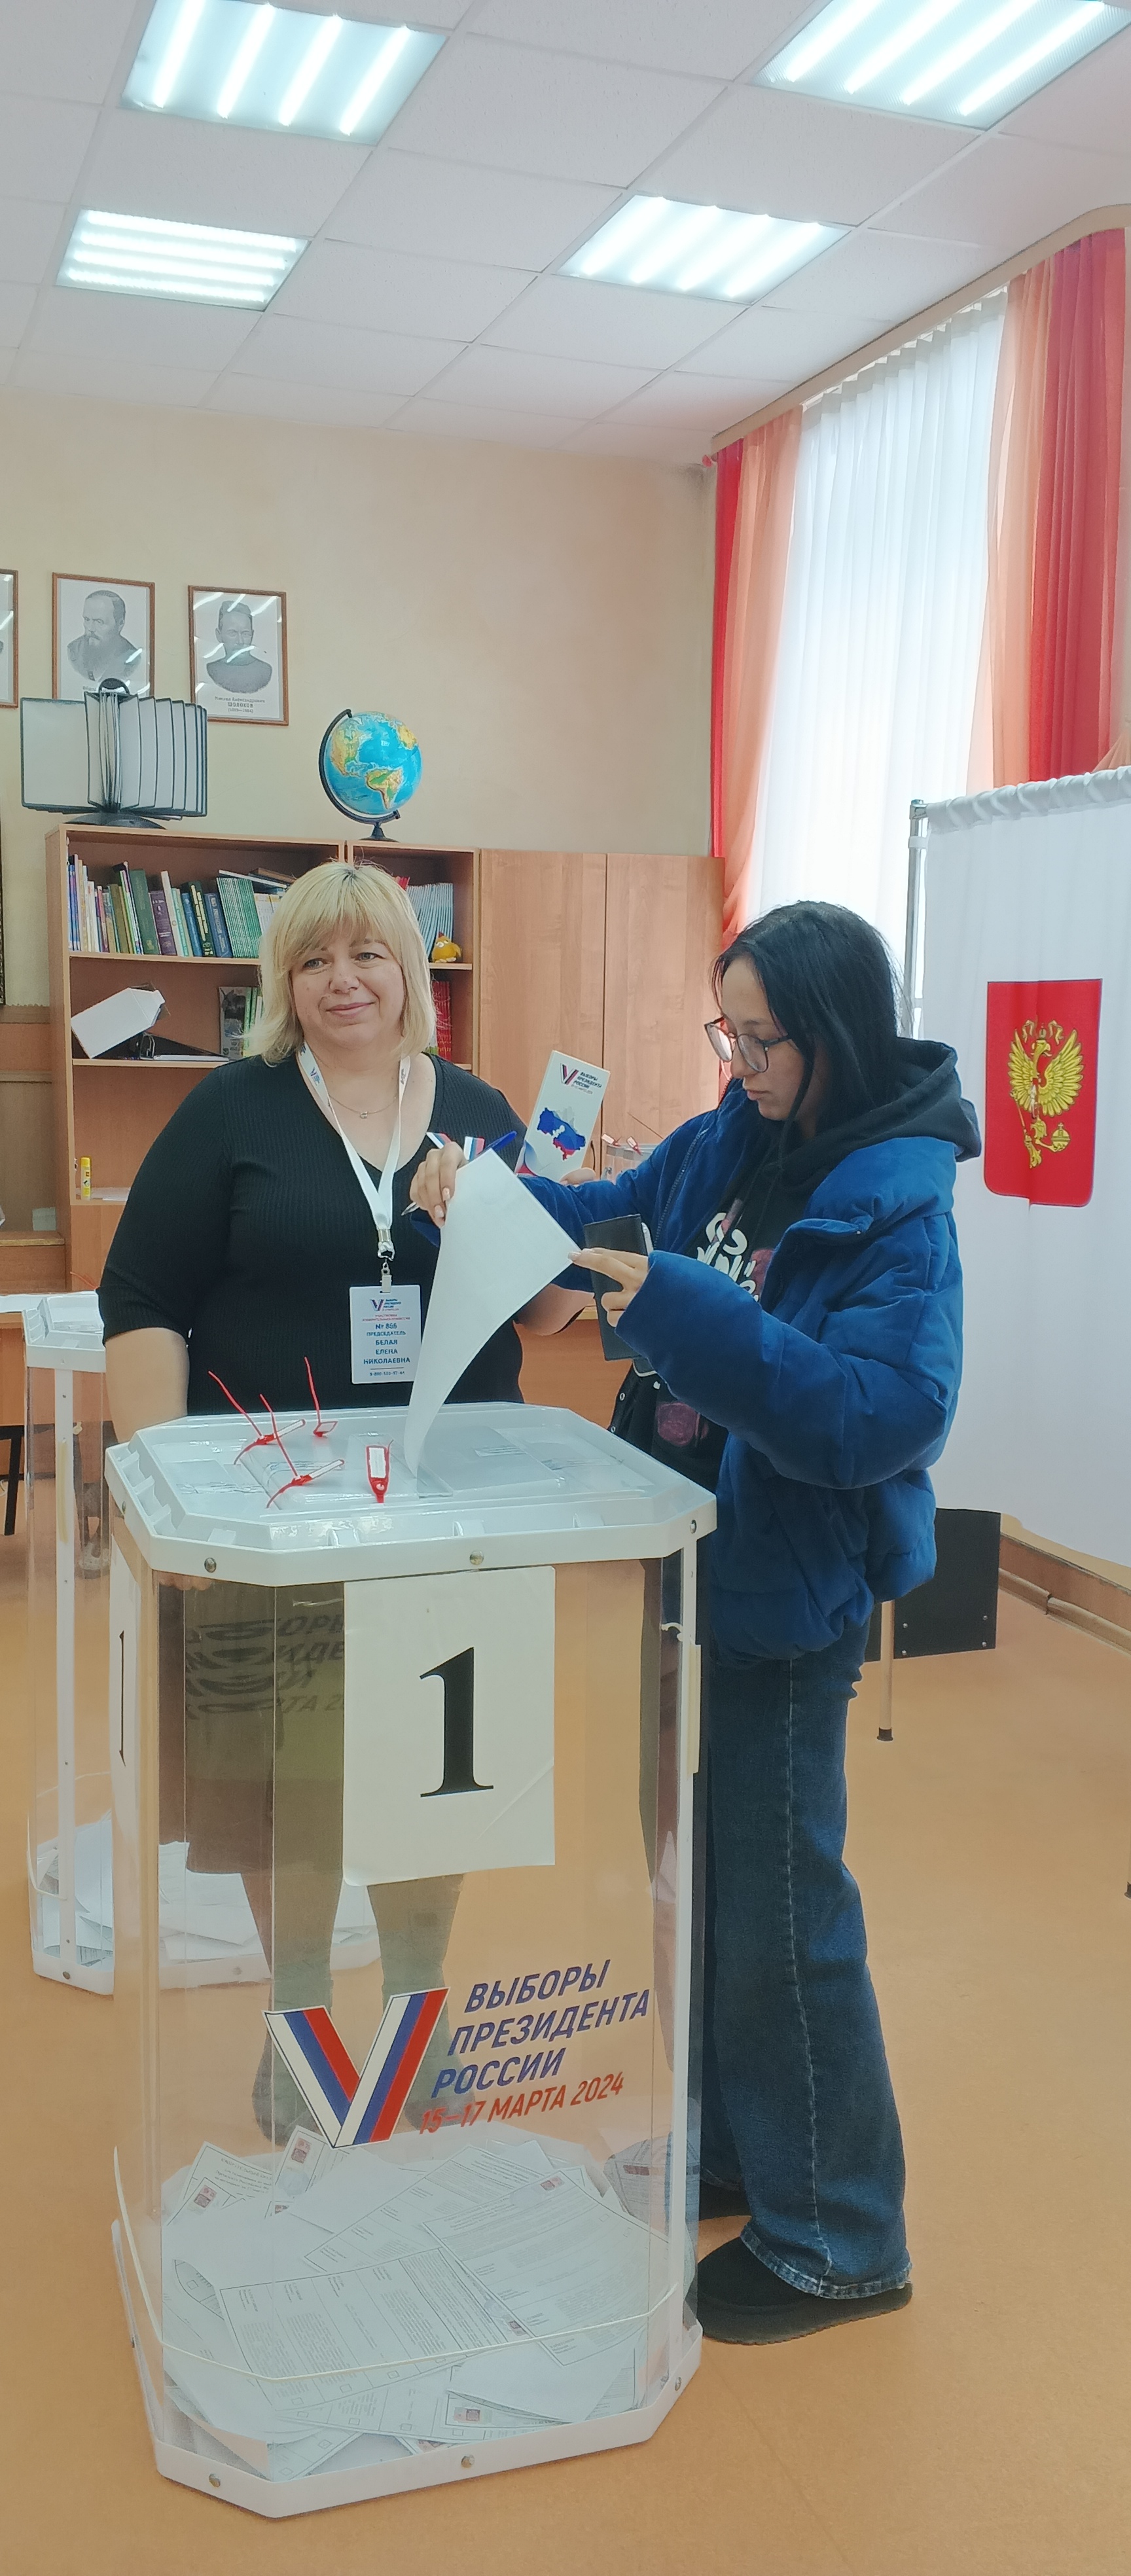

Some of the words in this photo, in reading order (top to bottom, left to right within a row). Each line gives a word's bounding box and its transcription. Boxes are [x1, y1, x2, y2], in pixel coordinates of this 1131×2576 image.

[420, 1647, 494, 1797] 1
[464, 1959, 611, 2013] ВЫБОРЫ
[447, 1989, 650, 2056] ПРЕЗИДЕНТА
[431, 2047, 566, 2099] РОССИИ
[488, 2084, 567, 2123] МАРТА
[570, 2071, 624, 2106] 2024
